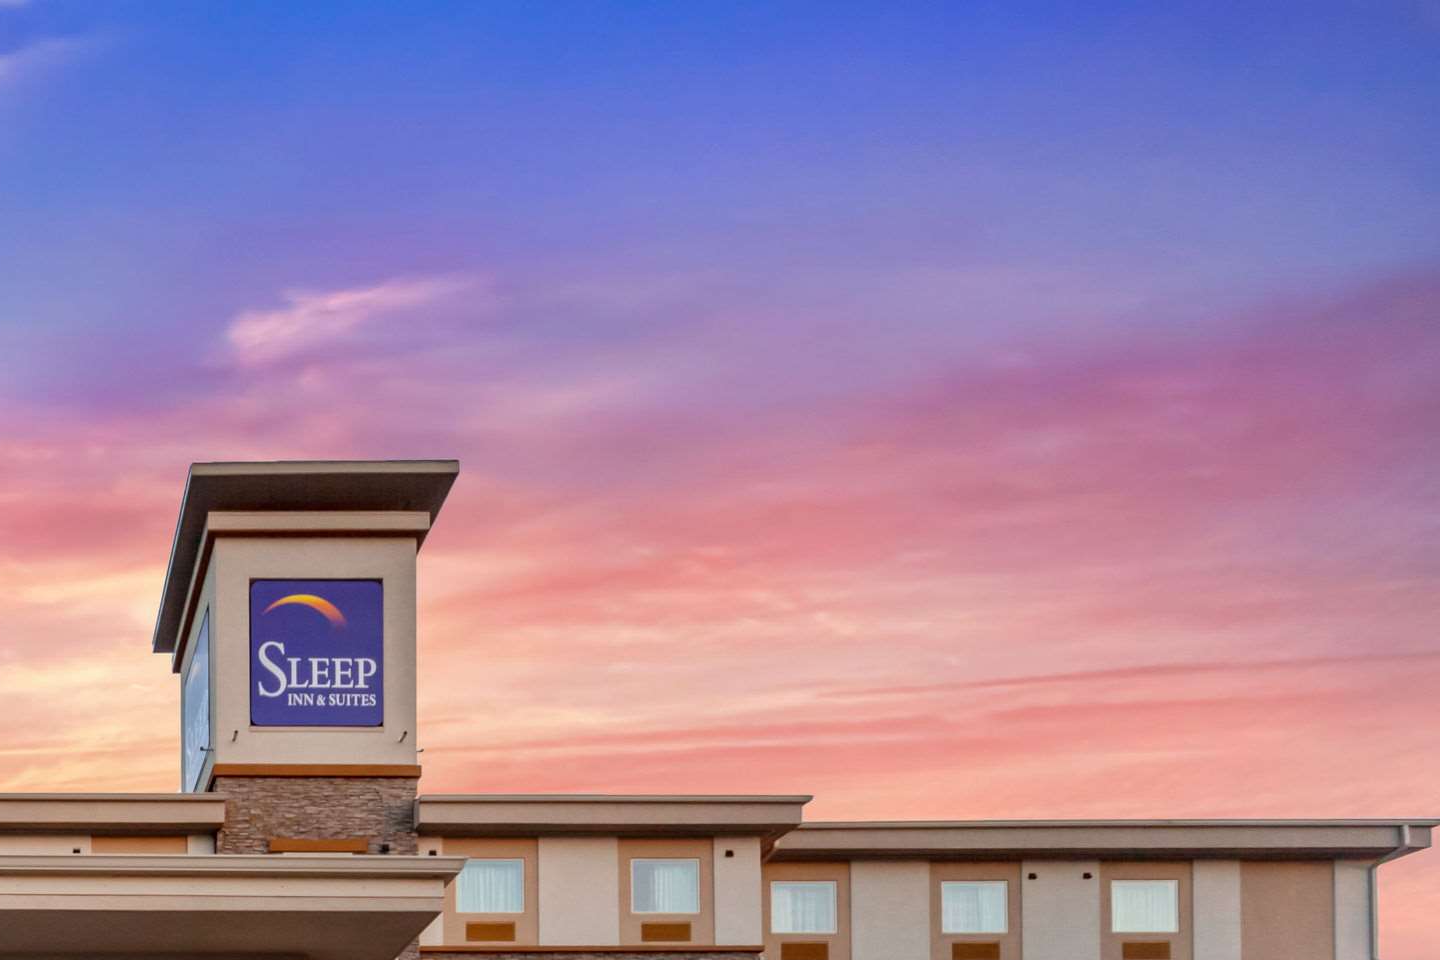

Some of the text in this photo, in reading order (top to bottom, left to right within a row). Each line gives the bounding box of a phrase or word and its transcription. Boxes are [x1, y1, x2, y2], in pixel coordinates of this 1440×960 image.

[257, 640, 377, 698] SLEEP
[287, 693, 377, 707] INN & SUITES
